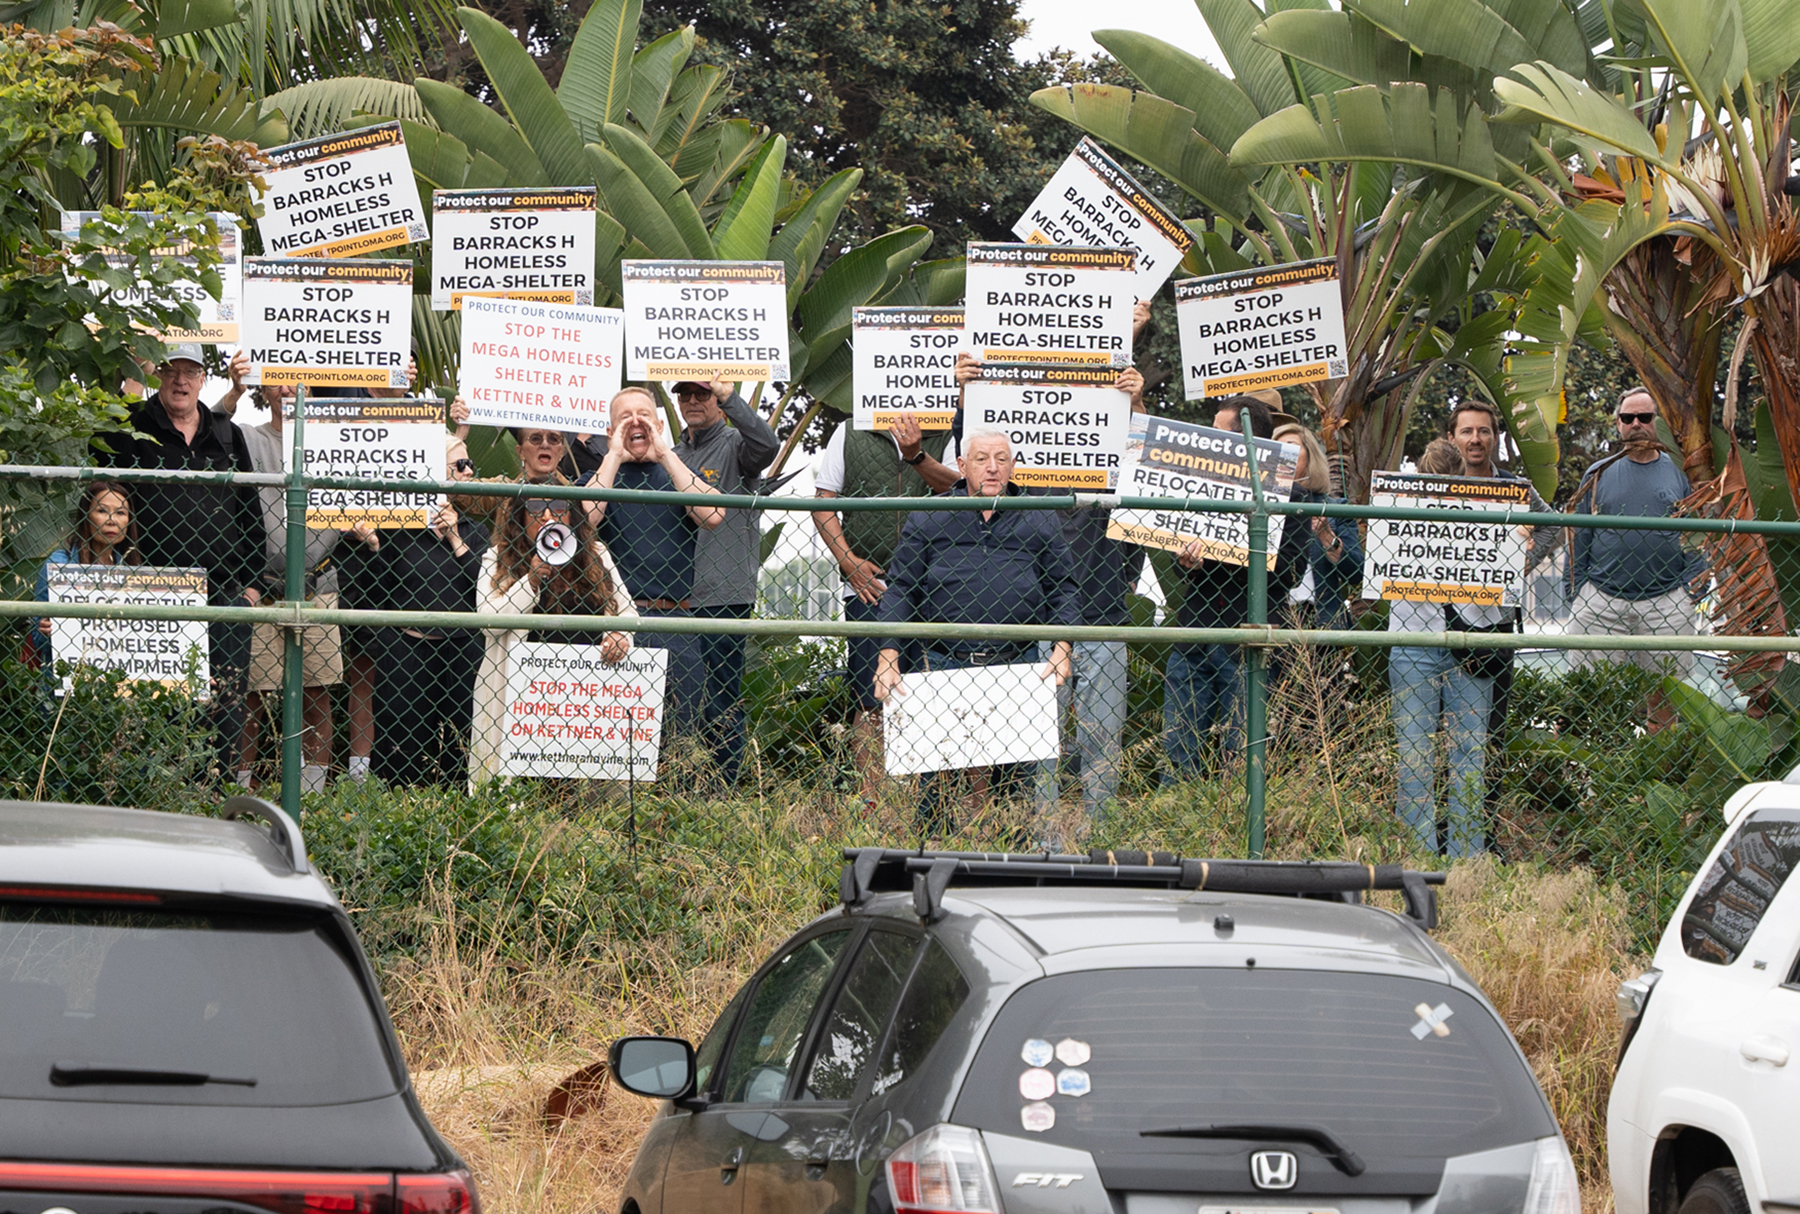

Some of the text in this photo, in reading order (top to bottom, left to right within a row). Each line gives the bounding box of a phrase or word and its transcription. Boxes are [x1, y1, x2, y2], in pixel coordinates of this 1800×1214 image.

[297, 146, 320, 159] our
[321, 128, 398, 153] community
[304, 161, 352, 183] STOP
[272, 172, 393, 210] BARRACKS H
[1079, 143, 1191, 248] Protect our community
[437, 193, 593, 207] Protect our community
[290, 193, 391, 226] HOMELESS
[1102, 195, 1141, 230] STOP
[271, 208, 415, 252] MEGA-SHELTER
[490, 216, 539, 230] STOP
[453, 235, 574, 250] BARRACKS H
[465, 255, 567, 270] HOMELESS
[972, 248, 1132, 266] Protect our community
[1140, 255, 1155, 271] H
[248, 263, 409, 280] Protect our community
[627, 266, 781, 280] Protect our community
[1025, 272, 1075, 287] STOP
[440, 274, 586, 290] MEGA-SHELTER
[1179, 264, 1335, 297] Protect our community
[303, 287, 353, 302] STOP
[681, 288, 729, 301] STOP
[987, 292, 1112, 309] BARRACKS H
[1234, 293, 1283, 312] STOP
[264, 308, 390, 324] BARRACKS H
[469, 302, 620, 325] PROTECT OUR COMMUNITY
[645, 307, 766, 321] BARRACKS H
[858, 313, 906, 323] Protect
[908, 314, 931, 323] our
[998, 313, 1104, 329] HOMELESS
[1200, 307, 1322, 338] BARRACKS H
[276, 329, 382, 344] HOMELESS
[505, 322, 582, 342] STOP THE
[658, 327, 760, 341] HOMELESS
[910, 335, 958, 348] STOP
[973, 332, 1123, 350] MEGA-SHELTER
[1214, 327, 1316, 355] HOMELESS
[250, 349, 401, 366] MEGA-SHELTER
[472, 342, 612, 368] MEGA HOMELESS
[635, 346, 780, 360] MEGA-SHELTER
[874, 355, 957, 368] BARRAC
[1191, 344, 1338, 379] MEGA-SHELTER
[265, 372, 386, 382] PROTECTPOINTLOMA.ORG
[495, 367, 587, 388] SHELTER AT
[1021, 369, 1045, 379] our
[1207, 367, 1325, 392] PROTECTPOINTLOMA.ORG
[473, 387, 606, 413] KETTNER & VINE
[1022, 390, 1072, 405] STOP
[337, 406, 361, 416] our
[362, 404, 442, 419] community
[984, 410, 1108, 426] BARRACKS H
[340, 428, 389, 442] STOP
[1009, 431, 1100, 446] OMELESS
[1155, 425, 1232, 456] Protect
[304, 449, 425, 463] BARRACKS H
[1015, 451, 1120, 467] A-SHELTER
[1133, 469, 1236, 499] RELOCATE
[1376, 478, 1528, 498] Protect our community
[308, 492, 438, 506] EGA-SHELTER
[1153, 514, 1240, 543] SHELTER
[1389, 523, 1507, 542] BARRACKS H
[1398, 544, 1498, 563] HOMELESS
[53, 571, 203, 587] Protect our community
[1373, 563, 1515, 584] MEGA-SHELTER
[82, 637, 180, 653] HOMELESS
[521, 658, 567, 669] PROTECT
[570, 659, 592, 670] OUR
[529, 681, 642, 699] STOP THE MEGA
[513, 702, 590, 718] HOMELESS
[511, 723, 533, 736] ON
[537, 724, 602, 740] KETTNER
[606, 727, 615, 740] &
[1012, 1172, 1084, 1189] FIT
